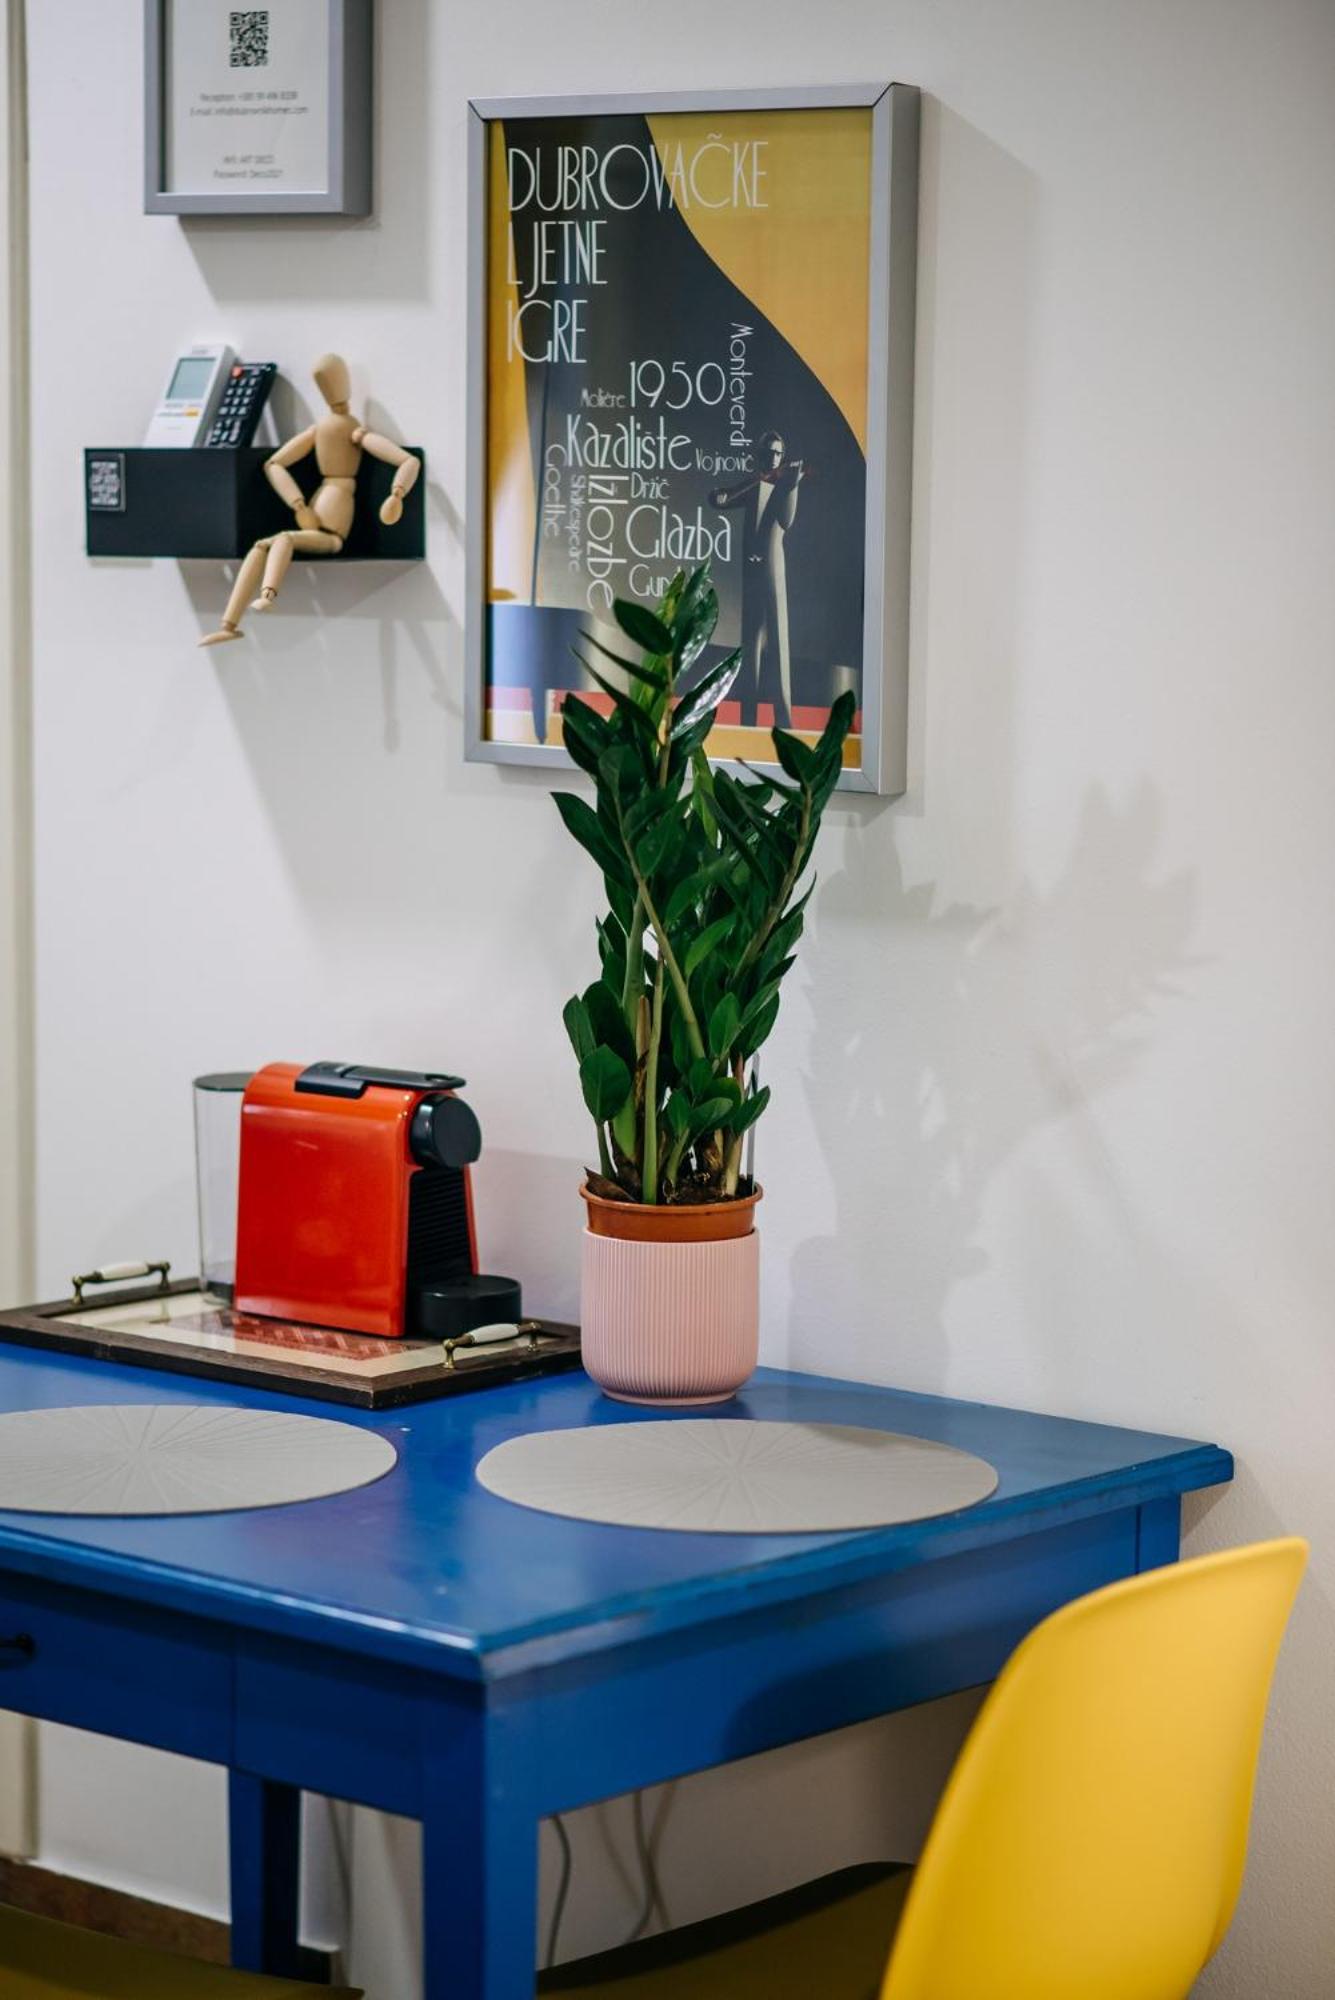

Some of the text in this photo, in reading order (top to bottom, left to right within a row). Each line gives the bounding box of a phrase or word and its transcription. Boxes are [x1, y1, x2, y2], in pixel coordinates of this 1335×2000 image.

[507, 220, 608, 299] LJETNE
[507, 299, 588, 364] IGRE
[629, 359, 726, 410] 1950
[729, 322, 754, 447] Monteverdi
[543, 443, 568, 538] Goethe
[625, 504, 731, 562] Glazba
